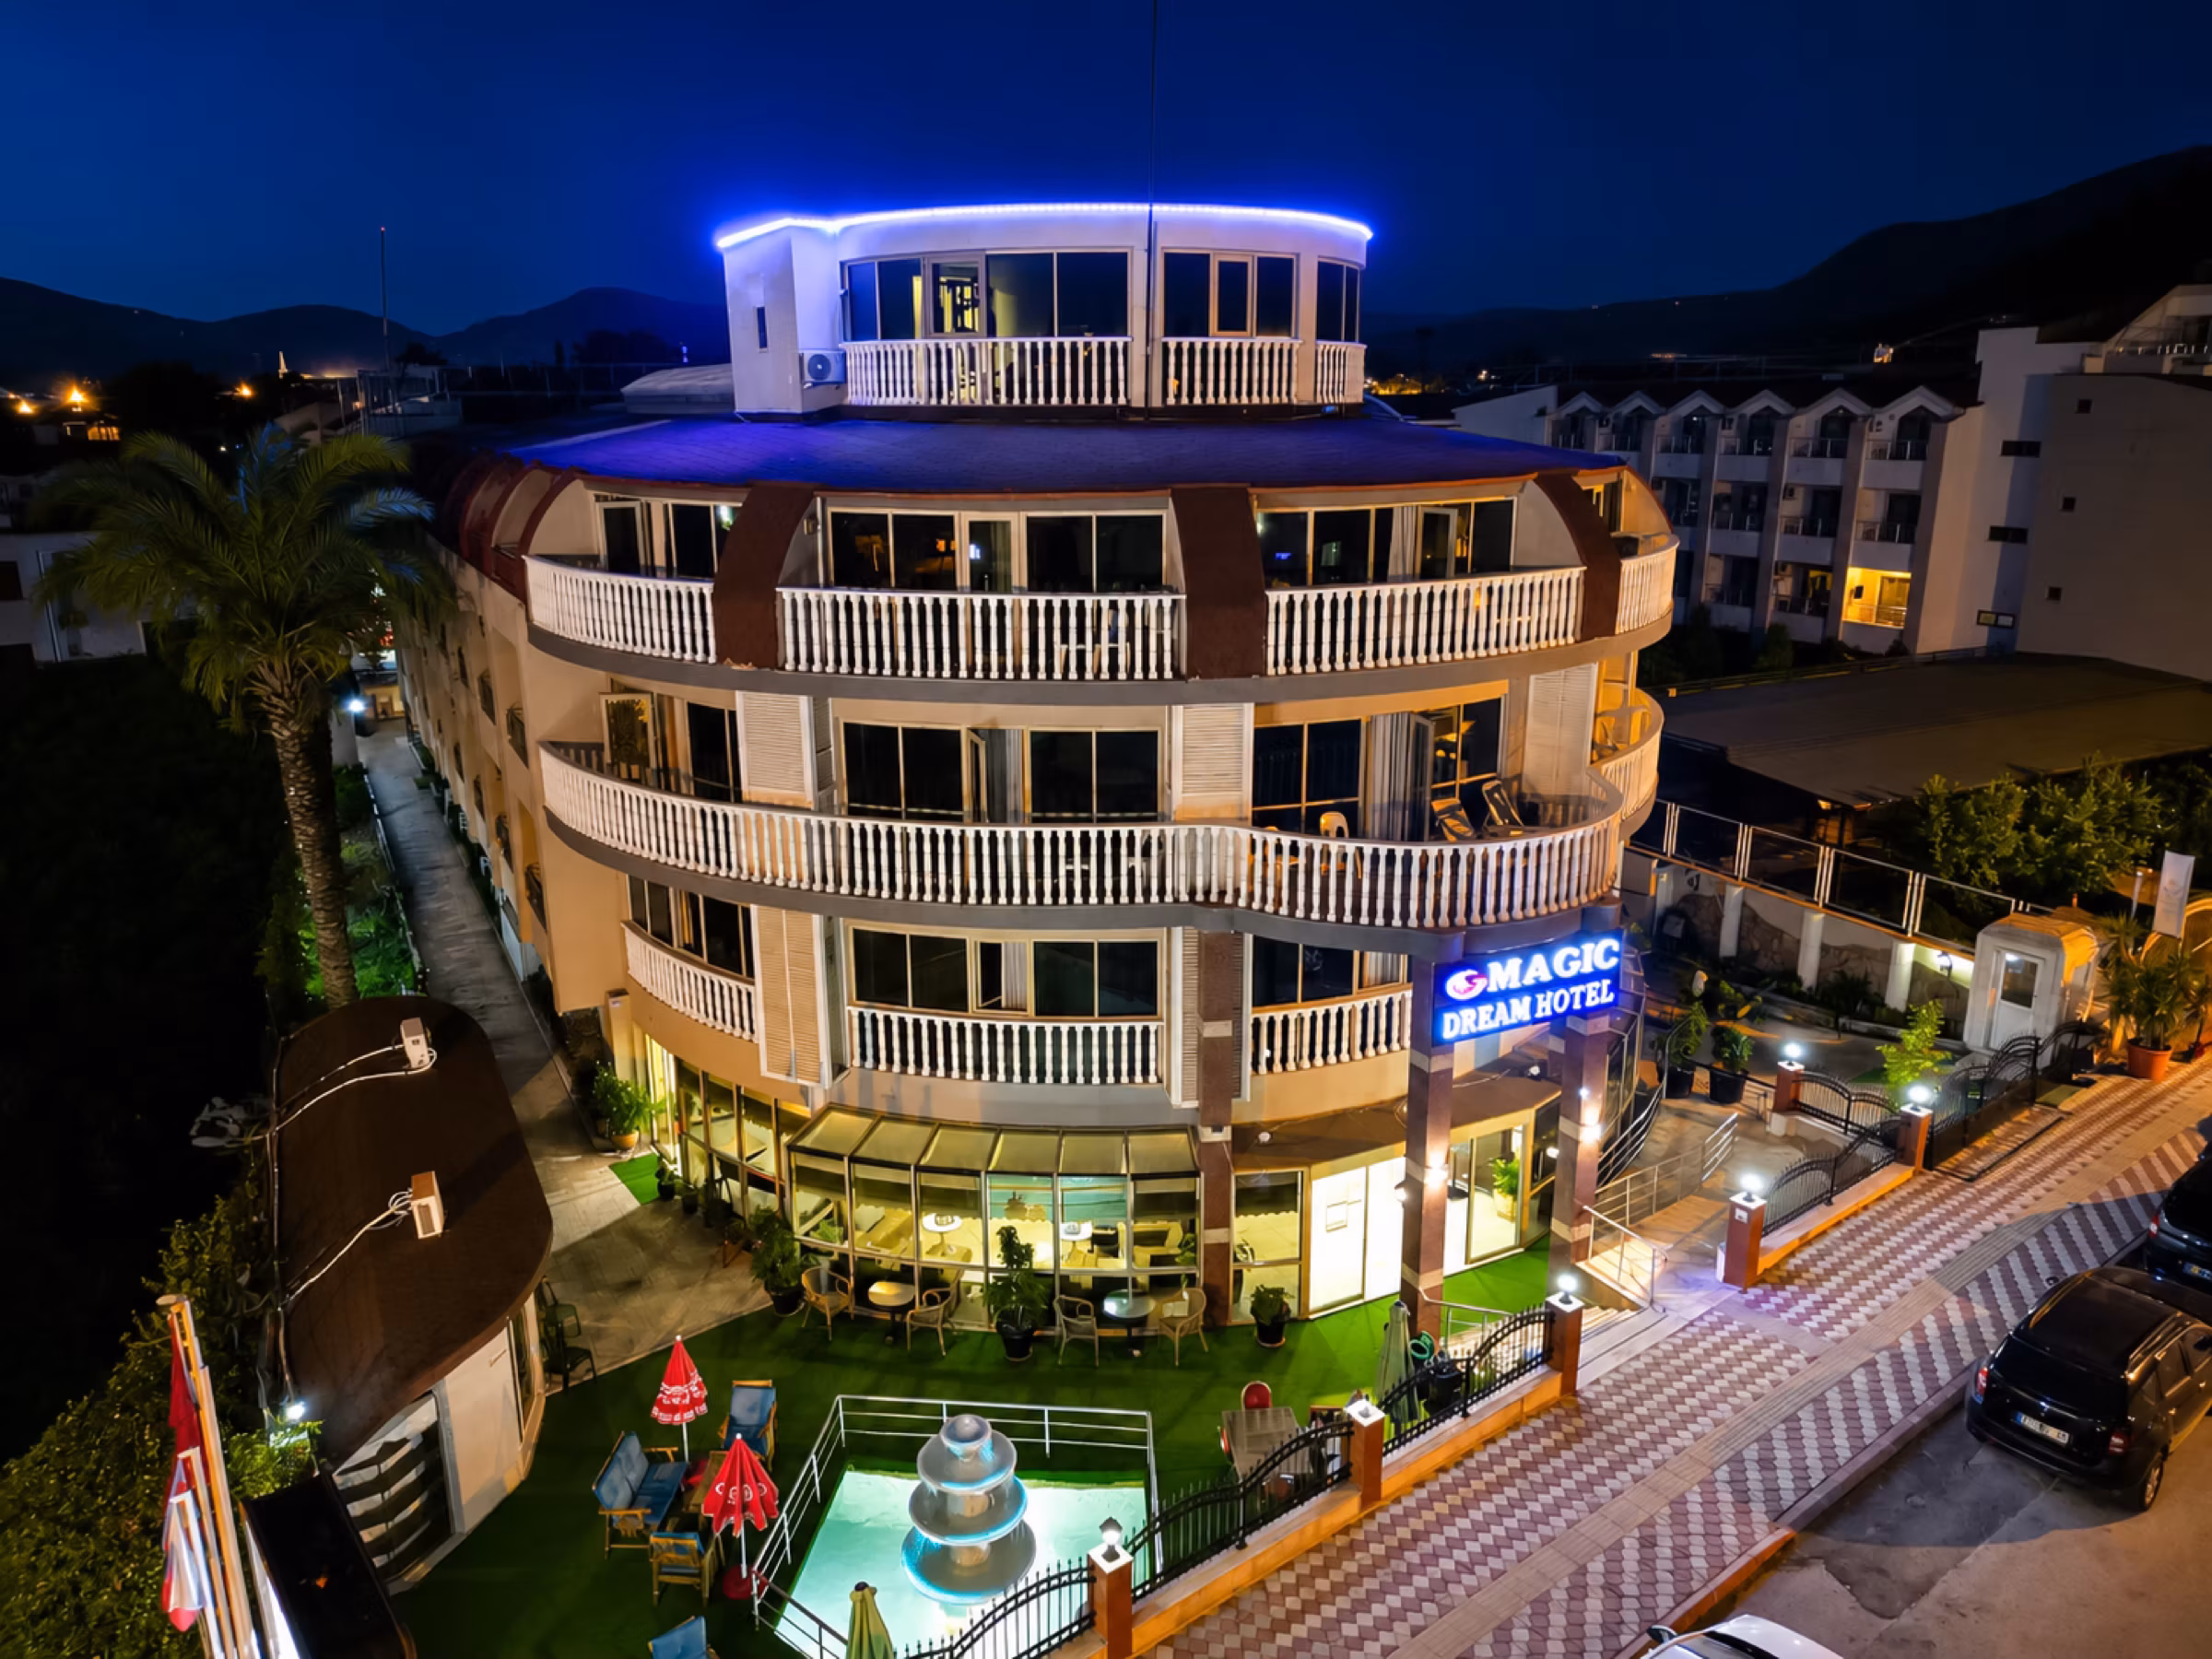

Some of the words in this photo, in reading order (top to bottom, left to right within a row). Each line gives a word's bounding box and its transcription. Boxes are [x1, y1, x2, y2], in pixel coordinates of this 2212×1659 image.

[1487, 938, 1620, 992] MAGIC
[1442, 995, 1532, 1040] DREAM
[1535, 979, 1615, 1018] HOTEL
